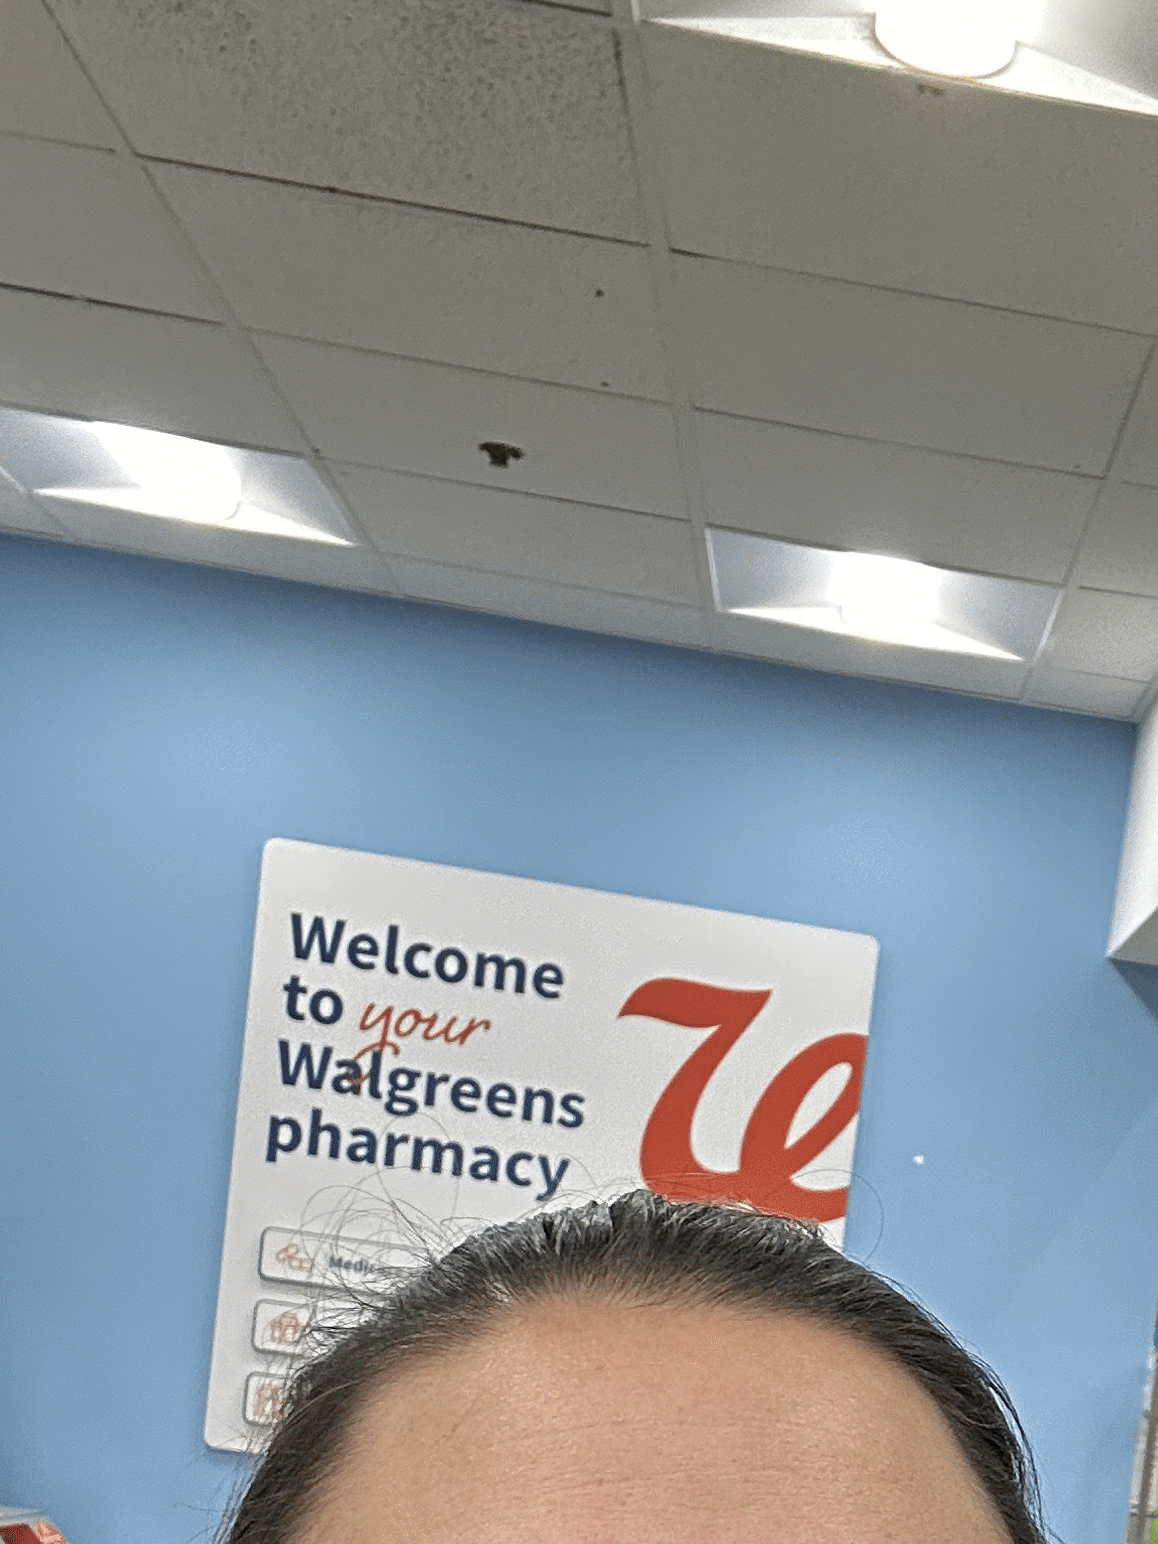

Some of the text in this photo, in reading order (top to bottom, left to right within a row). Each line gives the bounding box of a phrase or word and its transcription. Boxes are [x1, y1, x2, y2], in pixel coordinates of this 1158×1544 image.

[290, 911, 565, 1000] Welcome
[283, 974, 492, 1085] to your
[278, 1038, 586, 1129] Walgreens
[265, 1106, 571, 1201] pharmacy
